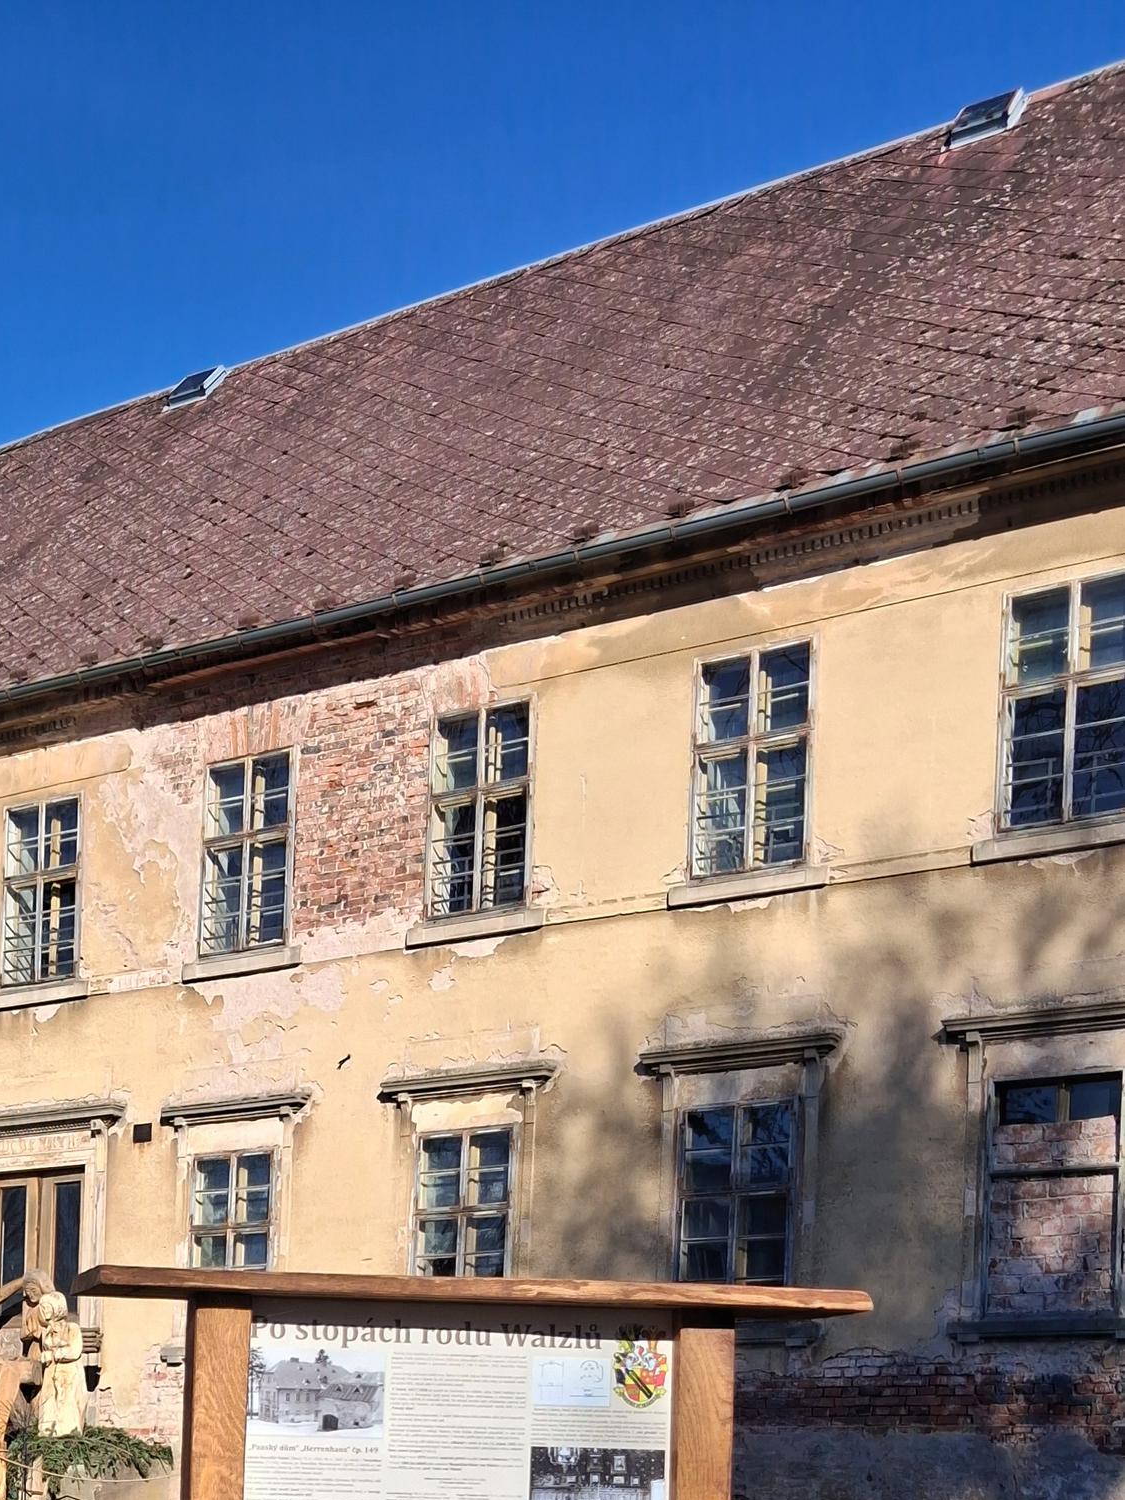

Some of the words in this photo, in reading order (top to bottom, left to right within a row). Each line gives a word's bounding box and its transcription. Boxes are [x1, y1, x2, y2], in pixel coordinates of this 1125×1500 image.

[250, 1316, 286, 1340] Po
[294, 1317, 411, 1348] stopách
[421, 1321, 492, 1347] rodu
[500, 1323, 603, 1350] Walzlů
